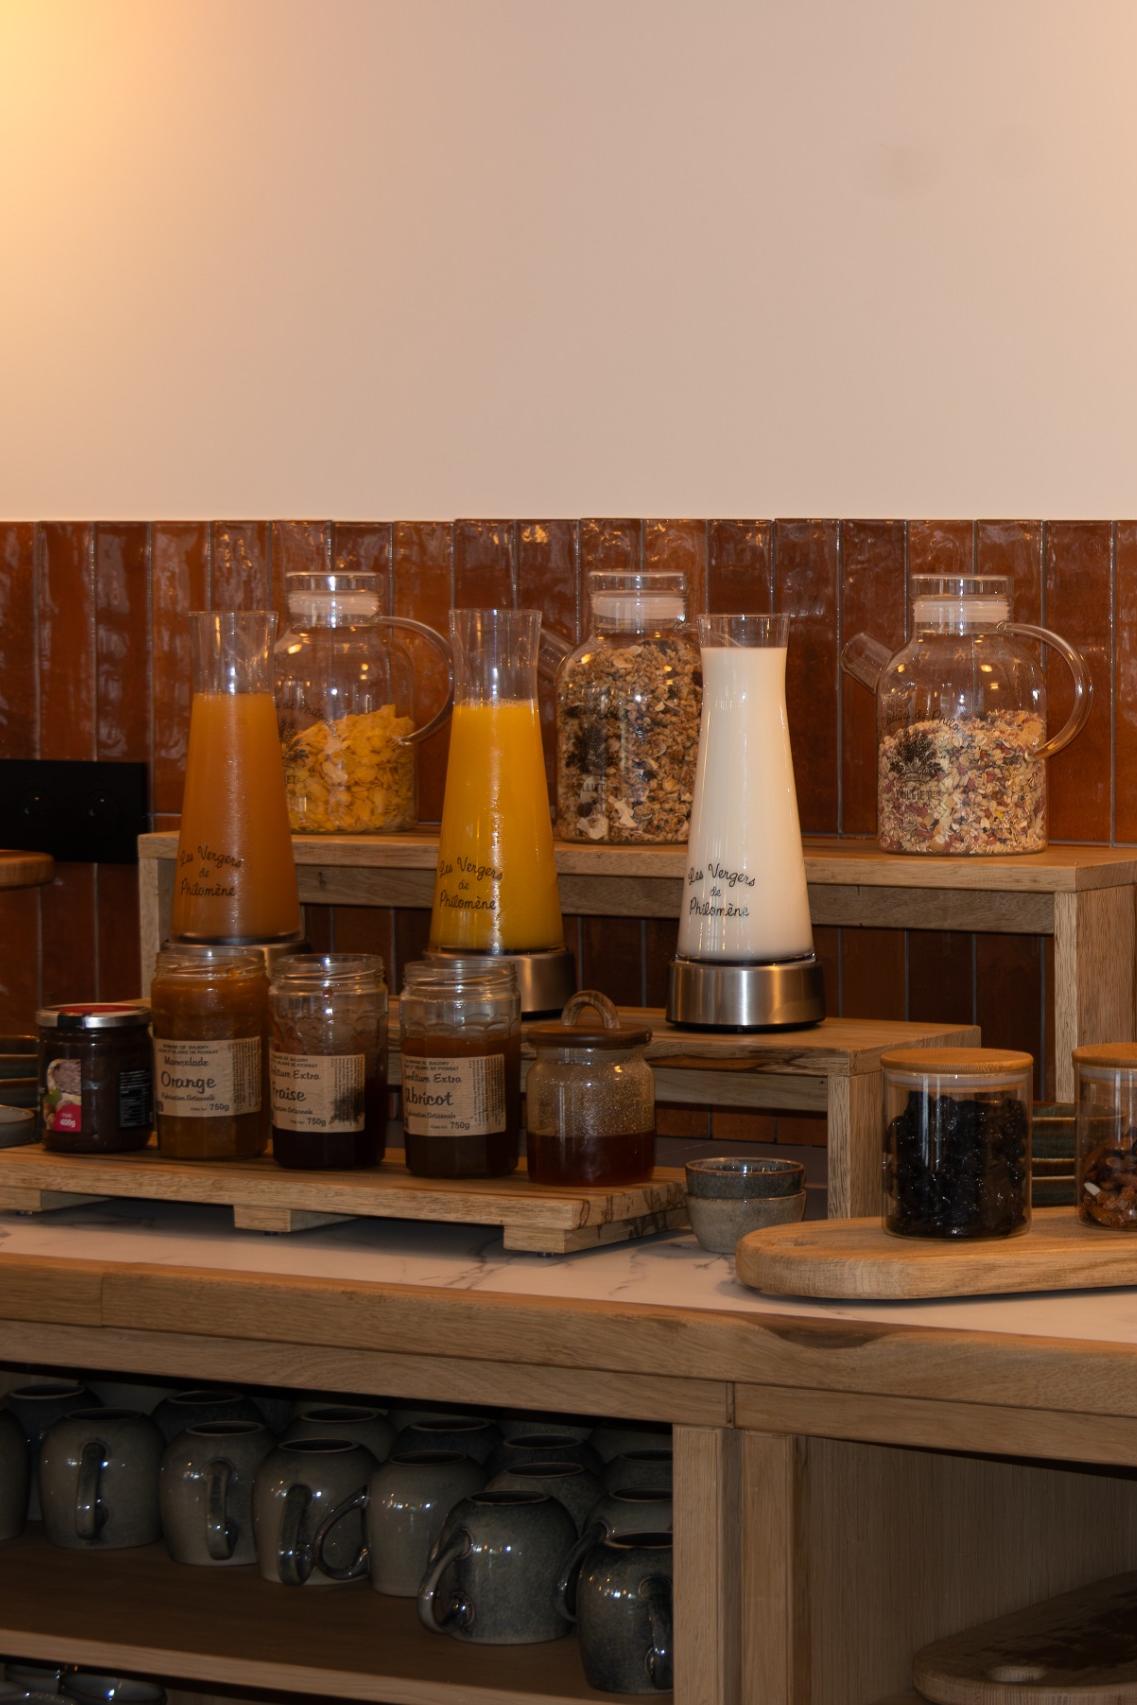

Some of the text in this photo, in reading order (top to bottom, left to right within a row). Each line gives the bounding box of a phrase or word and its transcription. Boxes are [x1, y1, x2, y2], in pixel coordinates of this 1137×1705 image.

[197, 845, 243, 869] Vergers
[457, 856, 503, 881] Vergers
[687, 863, 756, 888] Les Vergers
[440, 889, 497, 911] Philomène
[710, 886, 721, 897] de
[689, 896, 750, 917] Philomène
[160, 1070, 217, 1095] Orange
[433, 1073, 462, 1084] Extra
[208, 1103, 231, 1113] 750g
[308, 1116, 327, 1128] 750g
[450, 1119, 471, 1131] 750g
